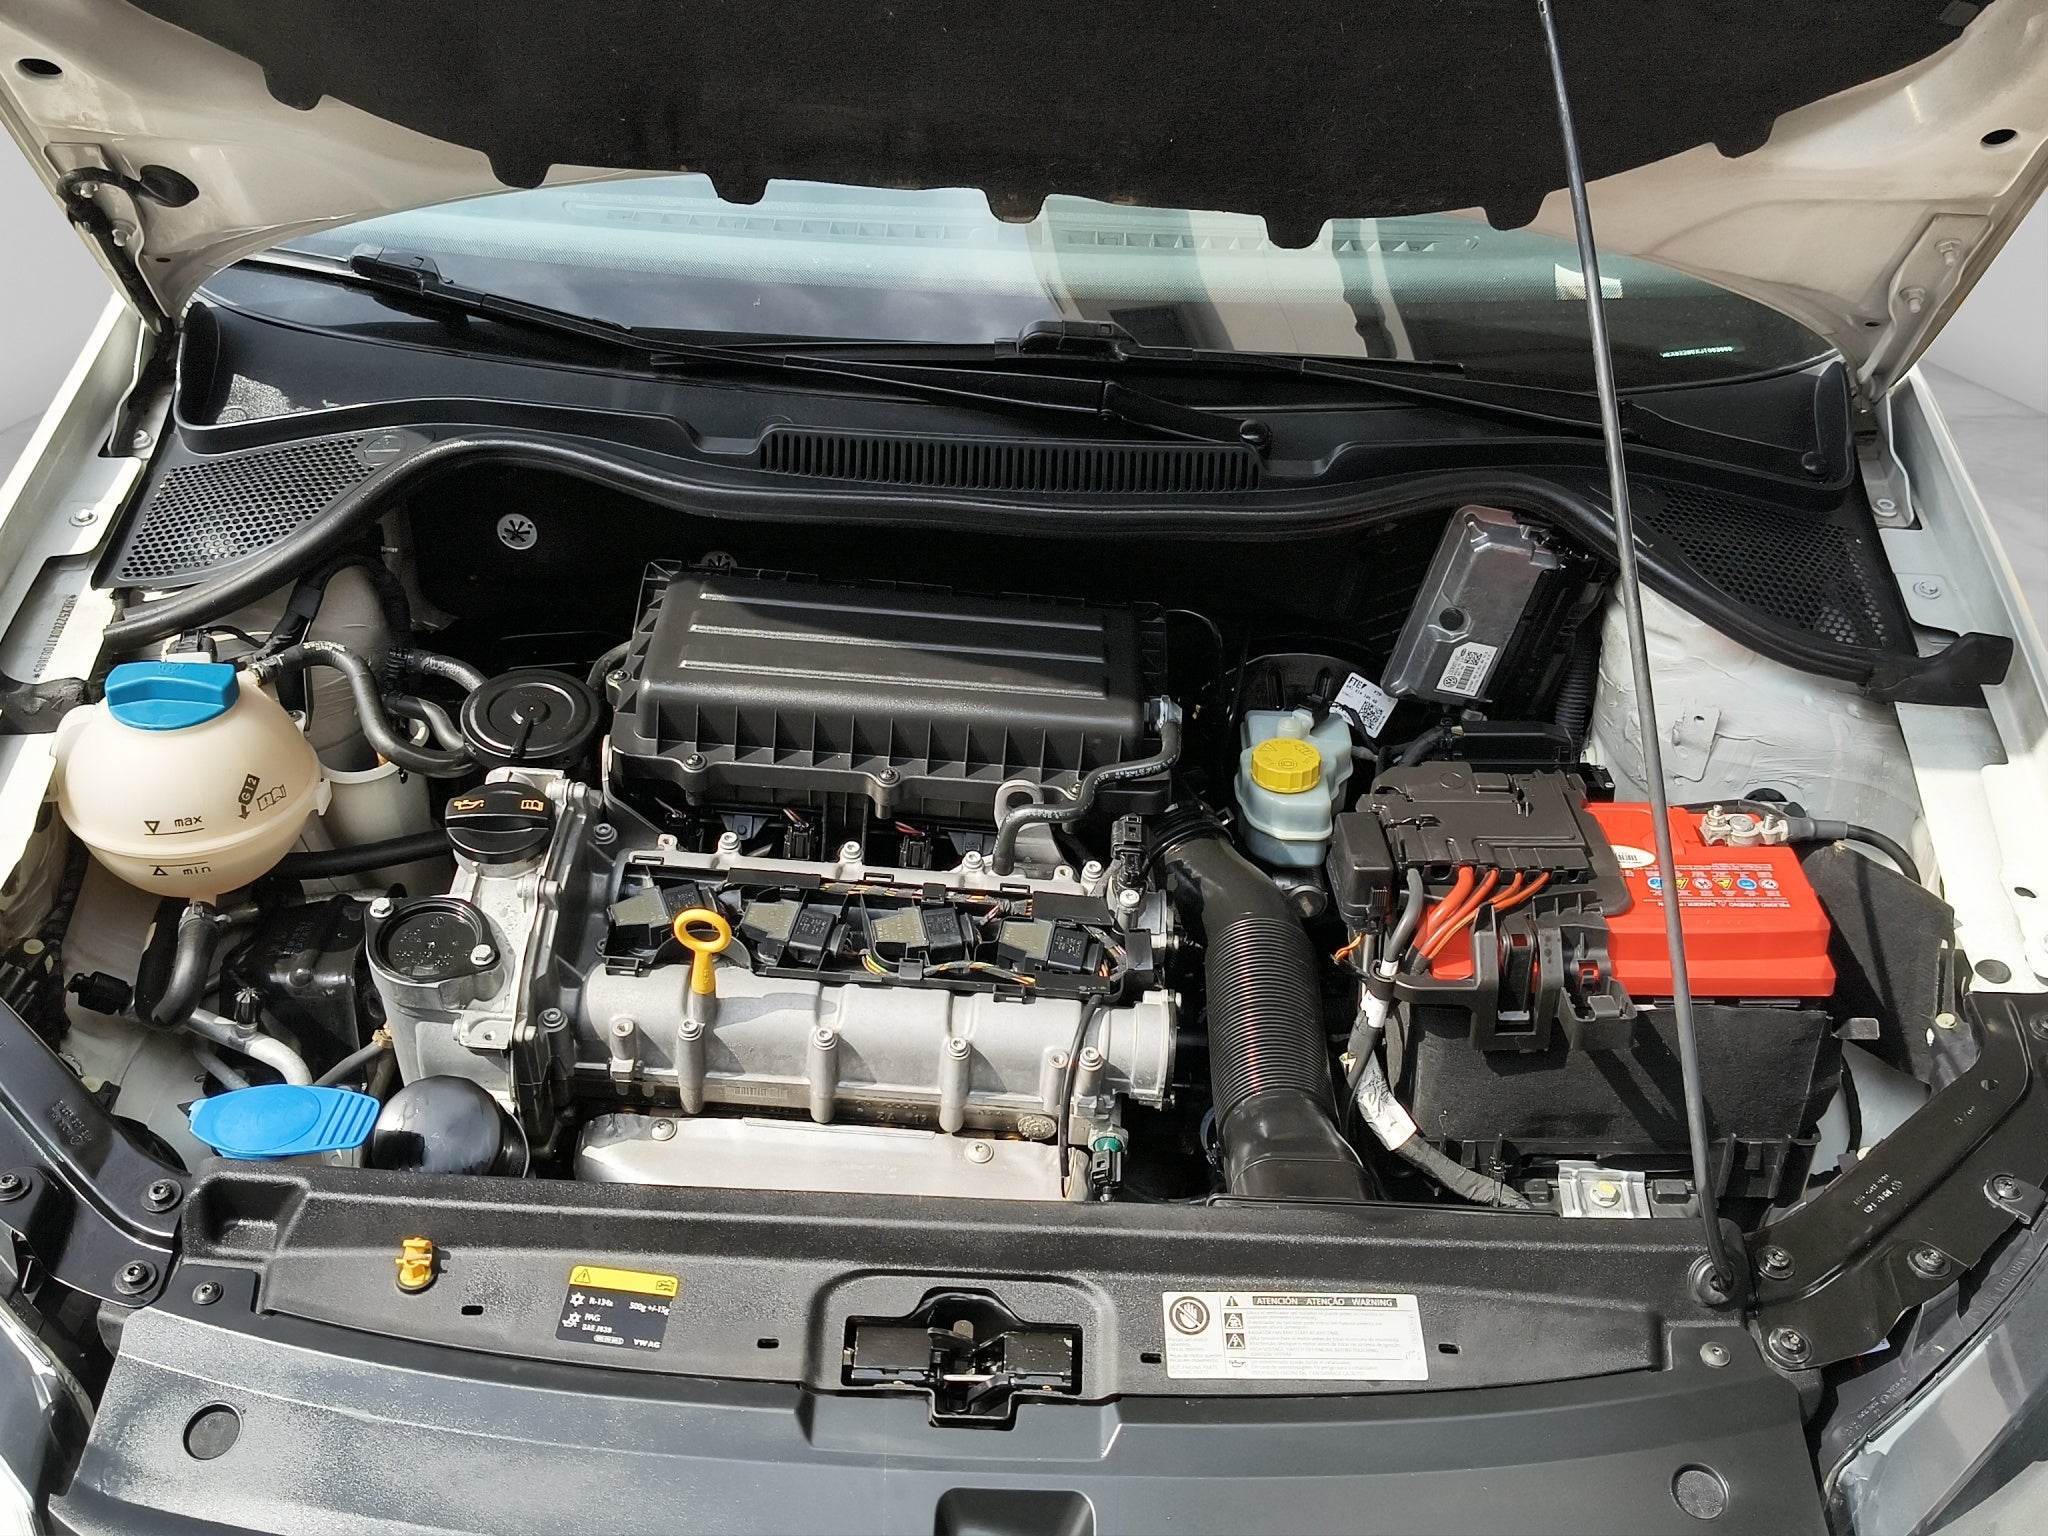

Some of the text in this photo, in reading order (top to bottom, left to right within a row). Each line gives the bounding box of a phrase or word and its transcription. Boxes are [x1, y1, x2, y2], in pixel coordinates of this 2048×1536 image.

[241, 777, 257, 801] G12
[174, 815, 203, 828] max
[183, 866, 212, 875] min
[589, 1297, 614, 1307] R-134a
[629, 1301, 647, 1313] 500g
[1256, 1296, 1393, 1307] ATENCIÓN ATENÇÃO WARNING
[584, 1313, 601, 1322] PAG
[581, 1324, 595, 1332] SAE
[633, 1338, 647, 1347] VW
[648, 1340, 661, 1349] AG
